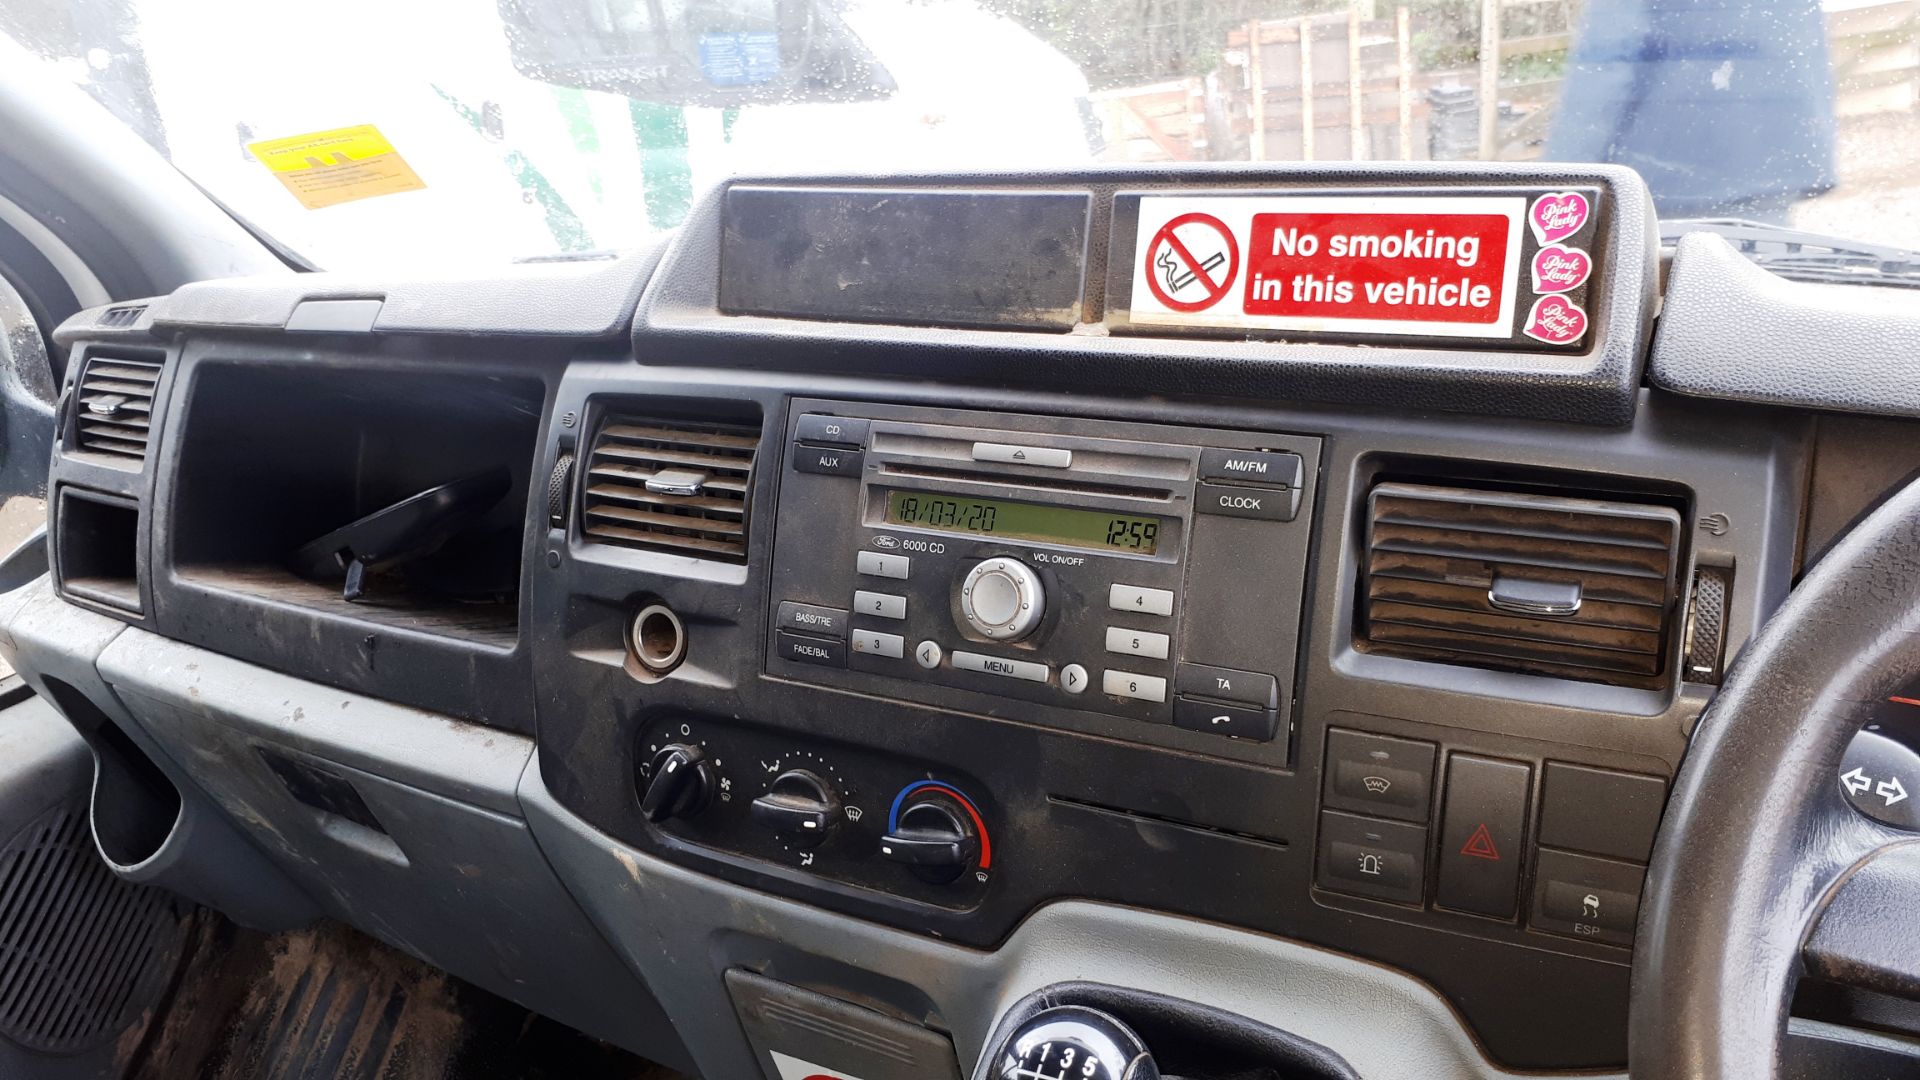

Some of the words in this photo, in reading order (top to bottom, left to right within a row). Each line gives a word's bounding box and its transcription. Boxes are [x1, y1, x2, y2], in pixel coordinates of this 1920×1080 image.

[1541, 199, 1577, 221] Pink
[1544, 212, 1579, 231] Lady
[1272, 228, 1319, 258] No
[1328, 229, 1480, 266] smoking
[1542, 255, 1579, 271] Pink
[1541, 269, 1578, 285] Lady
[1253, 275, 1284, 301] in
[1292, 275, 1354, 305] this
[1364, 277, 1491, 308] vehicle
[1542, 303, 1578, 328] Pink
[1537, 315, 1571, 338] Lady
[825, 424, 840, 435] CD
[819, 456, 838, 467] AUX
[1224, 459, 1267, 473] AM/FM
[1219, 495, 1260, 510] CLOCK
[900, 498, 996, 532] 18/03/20
[1106, 520, 1158, 549] 12:59
[903, 539, 927, 552] 6000
[929, 542, 945, 554] CD
[1033, 552, 1050, 563] VOL
[1052, 555, 1084, 567] ON/OFF
[875, 600, 882, 611] 2
[1135, 596, 1143, 606] 4
[795, 612, 832, 627] BASS/TRE
[873, 639, 880, 649] 3
[1131, 638, 1139, 649] 5
[793, 644, 830, 659] FADE/BAL
[984, 660, 1014, 674] MENU
[1129, 681, 1137, 692] 6
[1216, 678, 1231, 690] TA
[1574, 922, 1600, 936] ESP
[1018, 1039, 1035, 1058] R
[1041, 1042, 1052, 1062] 1
[1060, 1047, 1075, 1068] 3
[1082, 1055, 1098, 1076] 5
